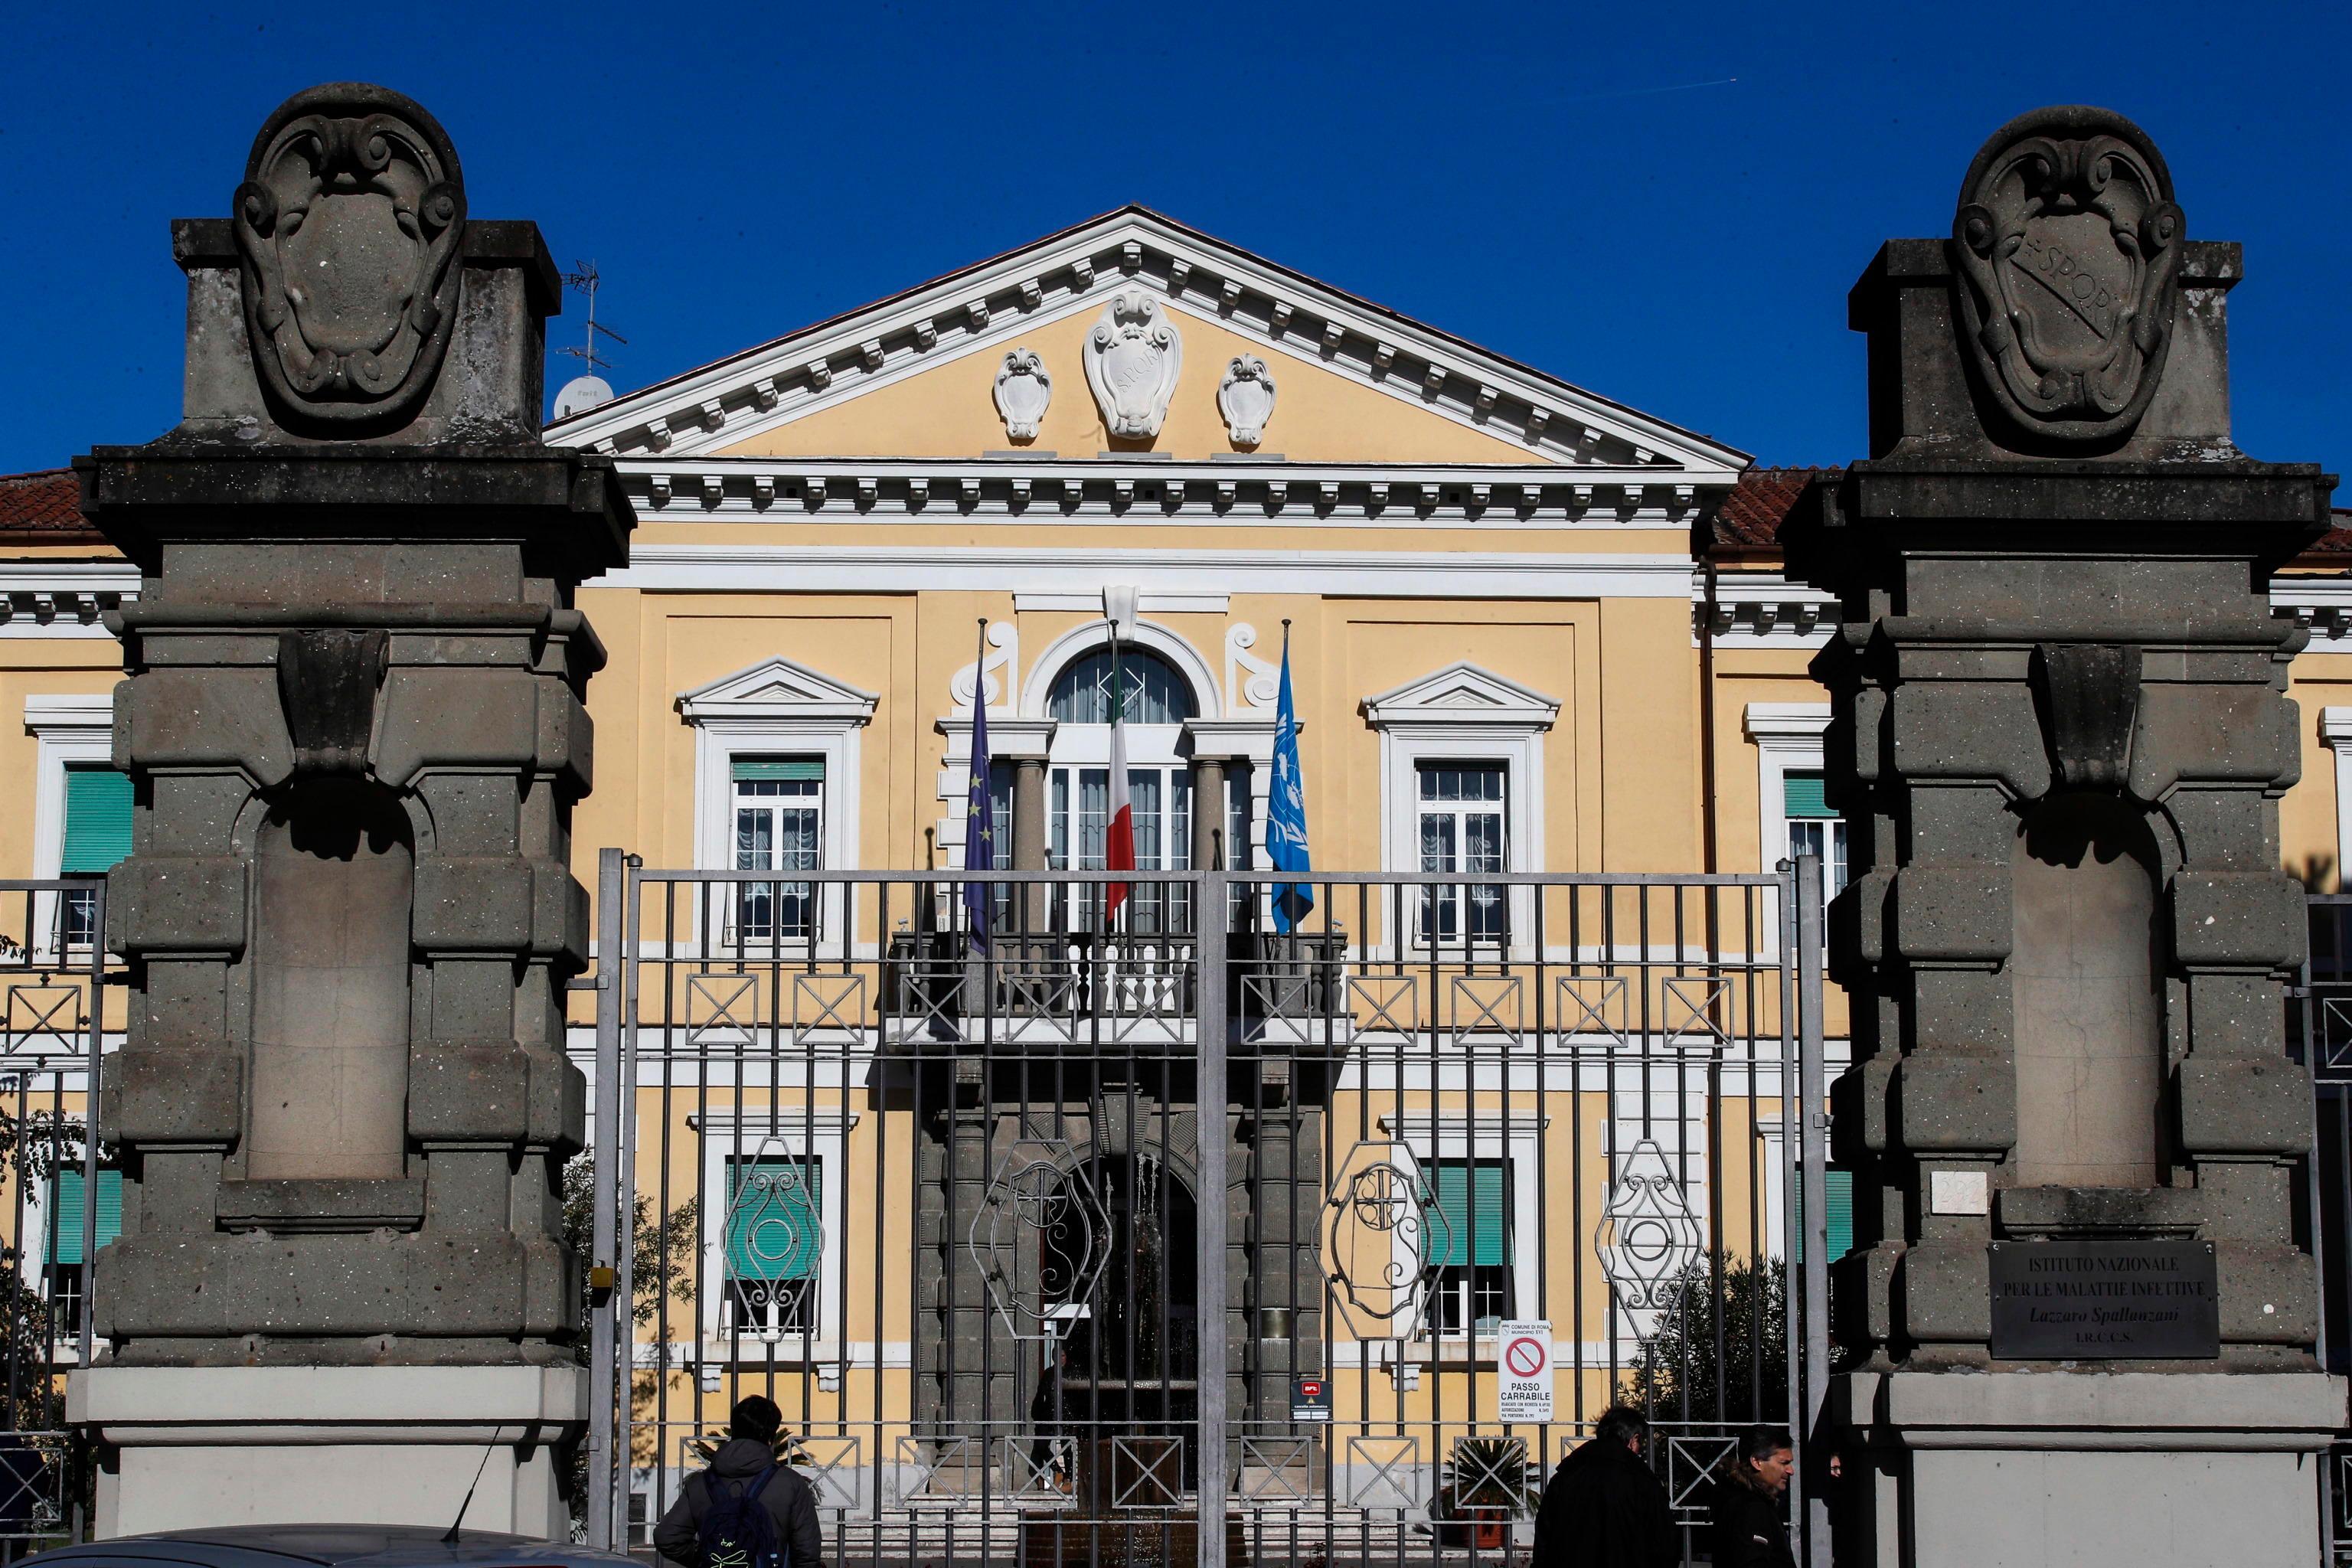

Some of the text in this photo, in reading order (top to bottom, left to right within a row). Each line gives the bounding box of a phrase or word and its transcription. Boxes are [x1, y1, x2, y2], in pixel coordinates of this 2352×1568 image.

[2029, 1256, 2179, 1272] ISTITUTO NAZIONALE
[2004, 1281, 2206, 1297] PER LE MALATTIE INFETTIVE
[2030, 1307, 2179, 1325] Lazzaro Spallanzani
[1511, 1383, 1540, 1391] PASSO
[1501, 1392, 1550, 1400] CARRABILE
